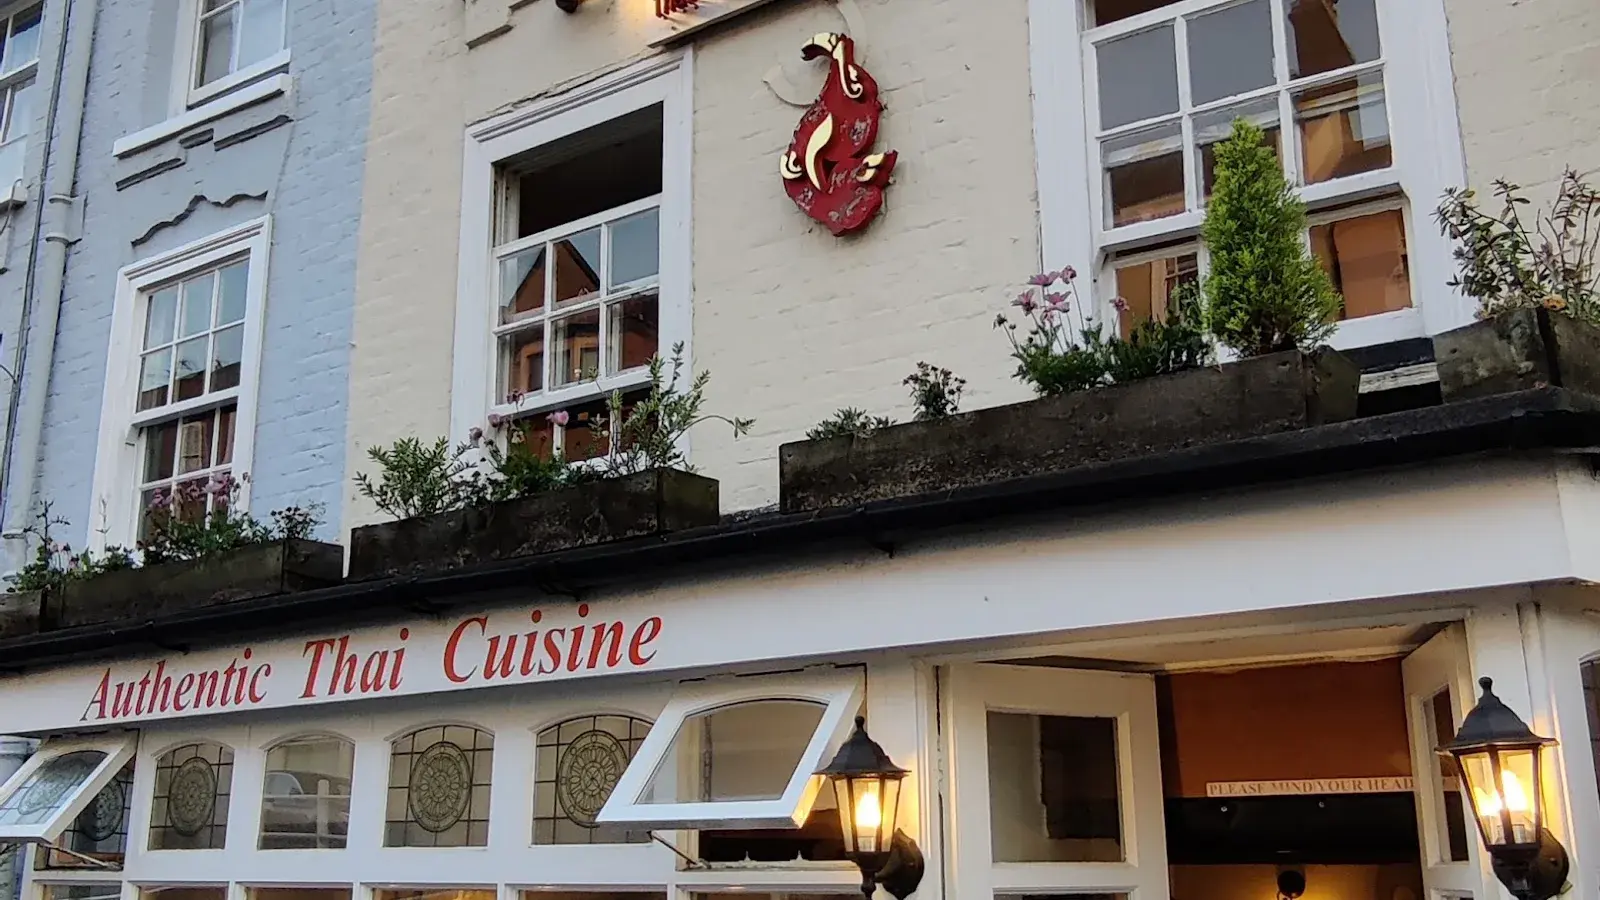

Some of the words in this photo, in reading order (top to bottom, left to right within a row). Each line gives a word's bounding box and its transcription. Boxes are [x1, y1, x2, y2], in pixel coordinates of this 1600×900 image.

[81, 648, 271, 722] Authentic
[299, 627, 410, 699] Thai
[443, 604, 663, 683] Cuisine
[1208, 783, 1263, 796] PLEASE
[1315, 779, 1363, 792] YOUR
